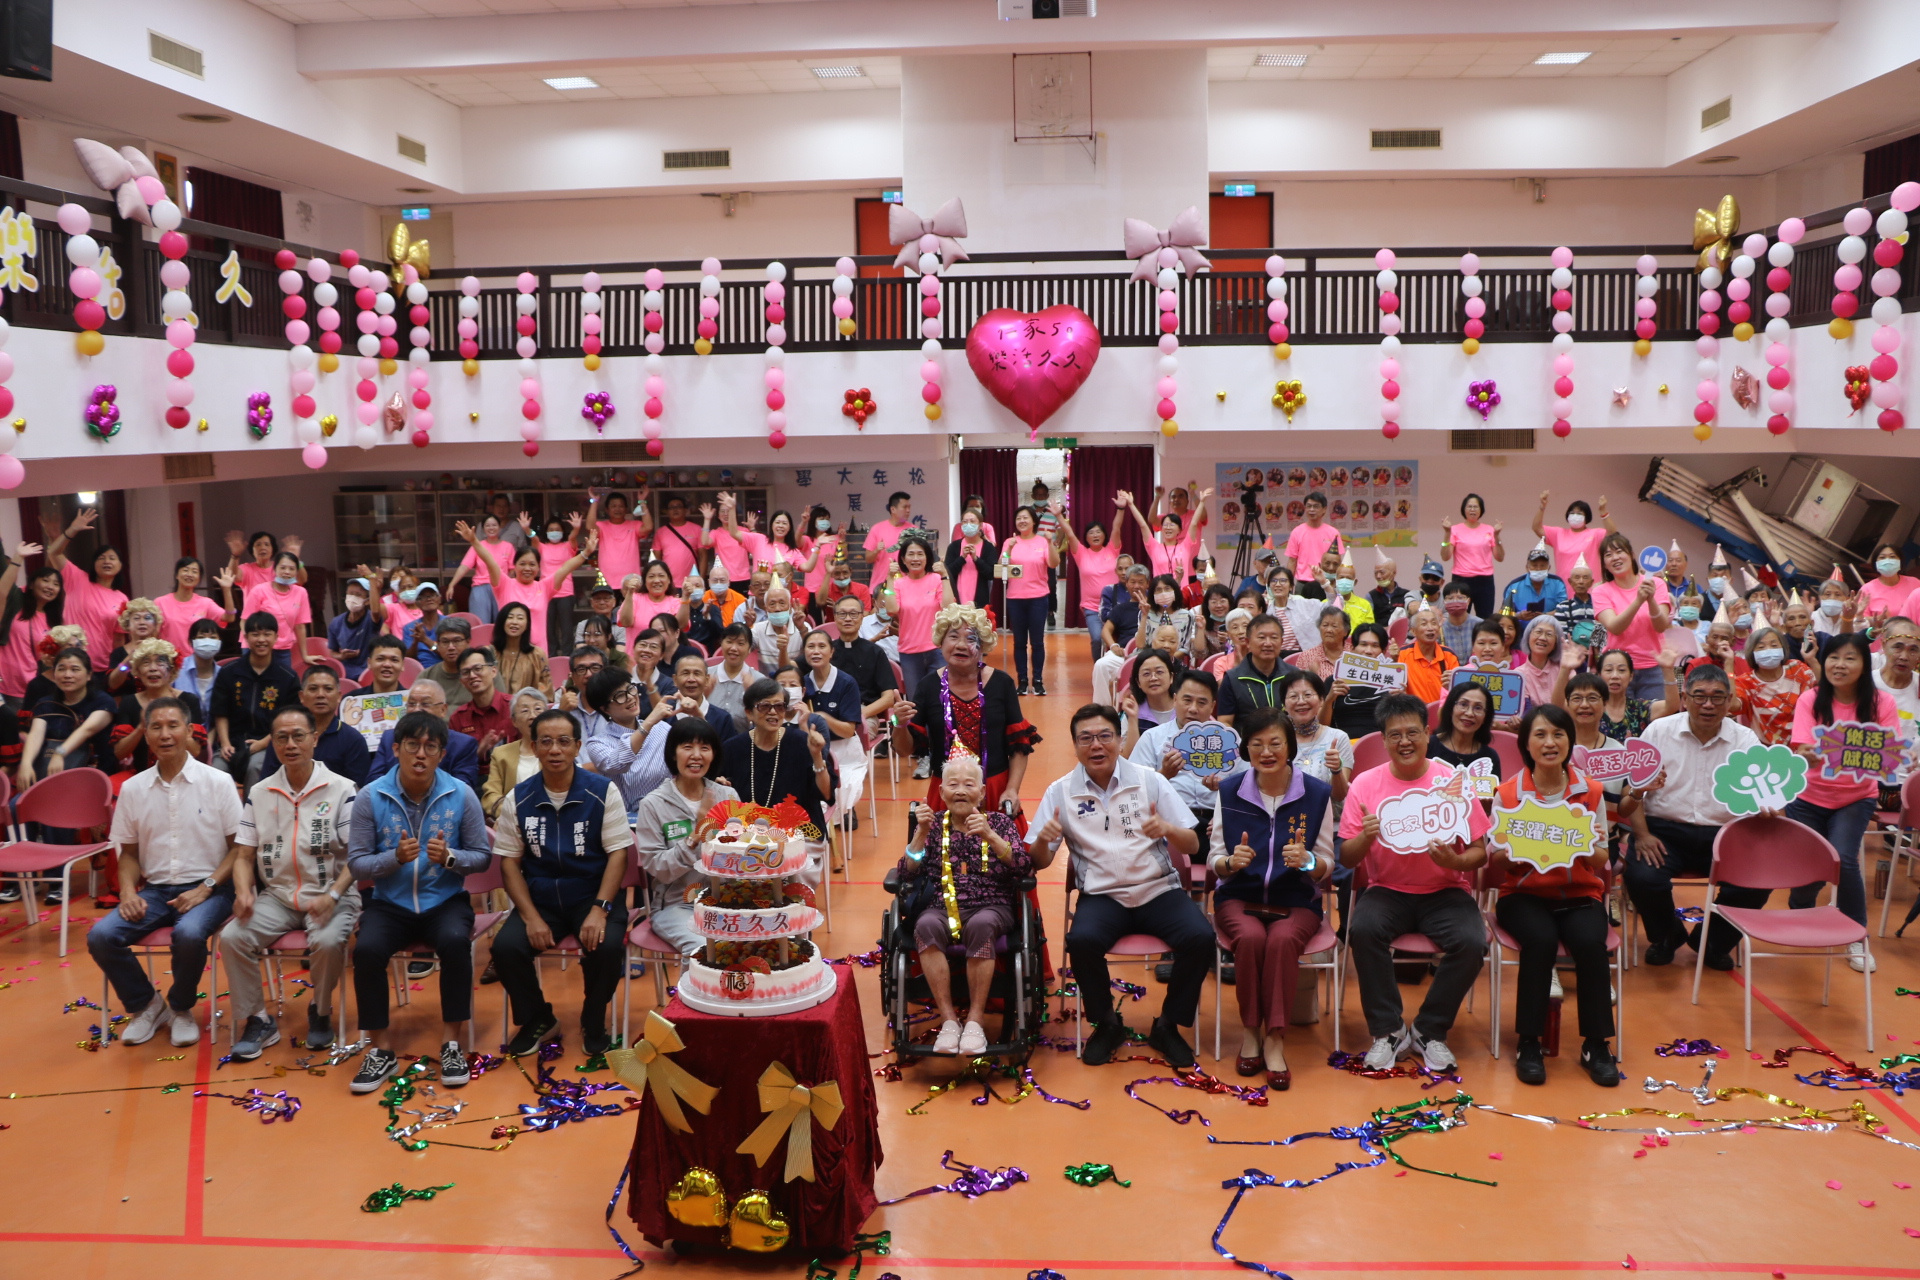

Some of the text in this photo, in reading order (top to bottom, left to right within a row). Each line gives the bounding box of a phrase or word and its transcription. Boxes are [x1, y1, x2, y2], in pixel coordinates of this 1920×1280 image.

[1347, 655, 1375, 669] 仁愛之家
[1346, 667, 1395, 686] 生日快樂
[1190, 735, 1223, 750] 健康
[1845, 727, 1885, 749] 樂活
[1189, 751, 1223, 769] 守護
[1588, 748, 1658, 775] 樂活久久
[1842, 749, 1881, 770] 賦能
[1118, 803, 1136, 839] 劉和然
[1384, 800, 1458, 837] 仁家50
[1505, 818, 1585, 848] 活躍老化
[703, 910, 790, 934] 樂活久久
[726, 971, 751, 992] 福
